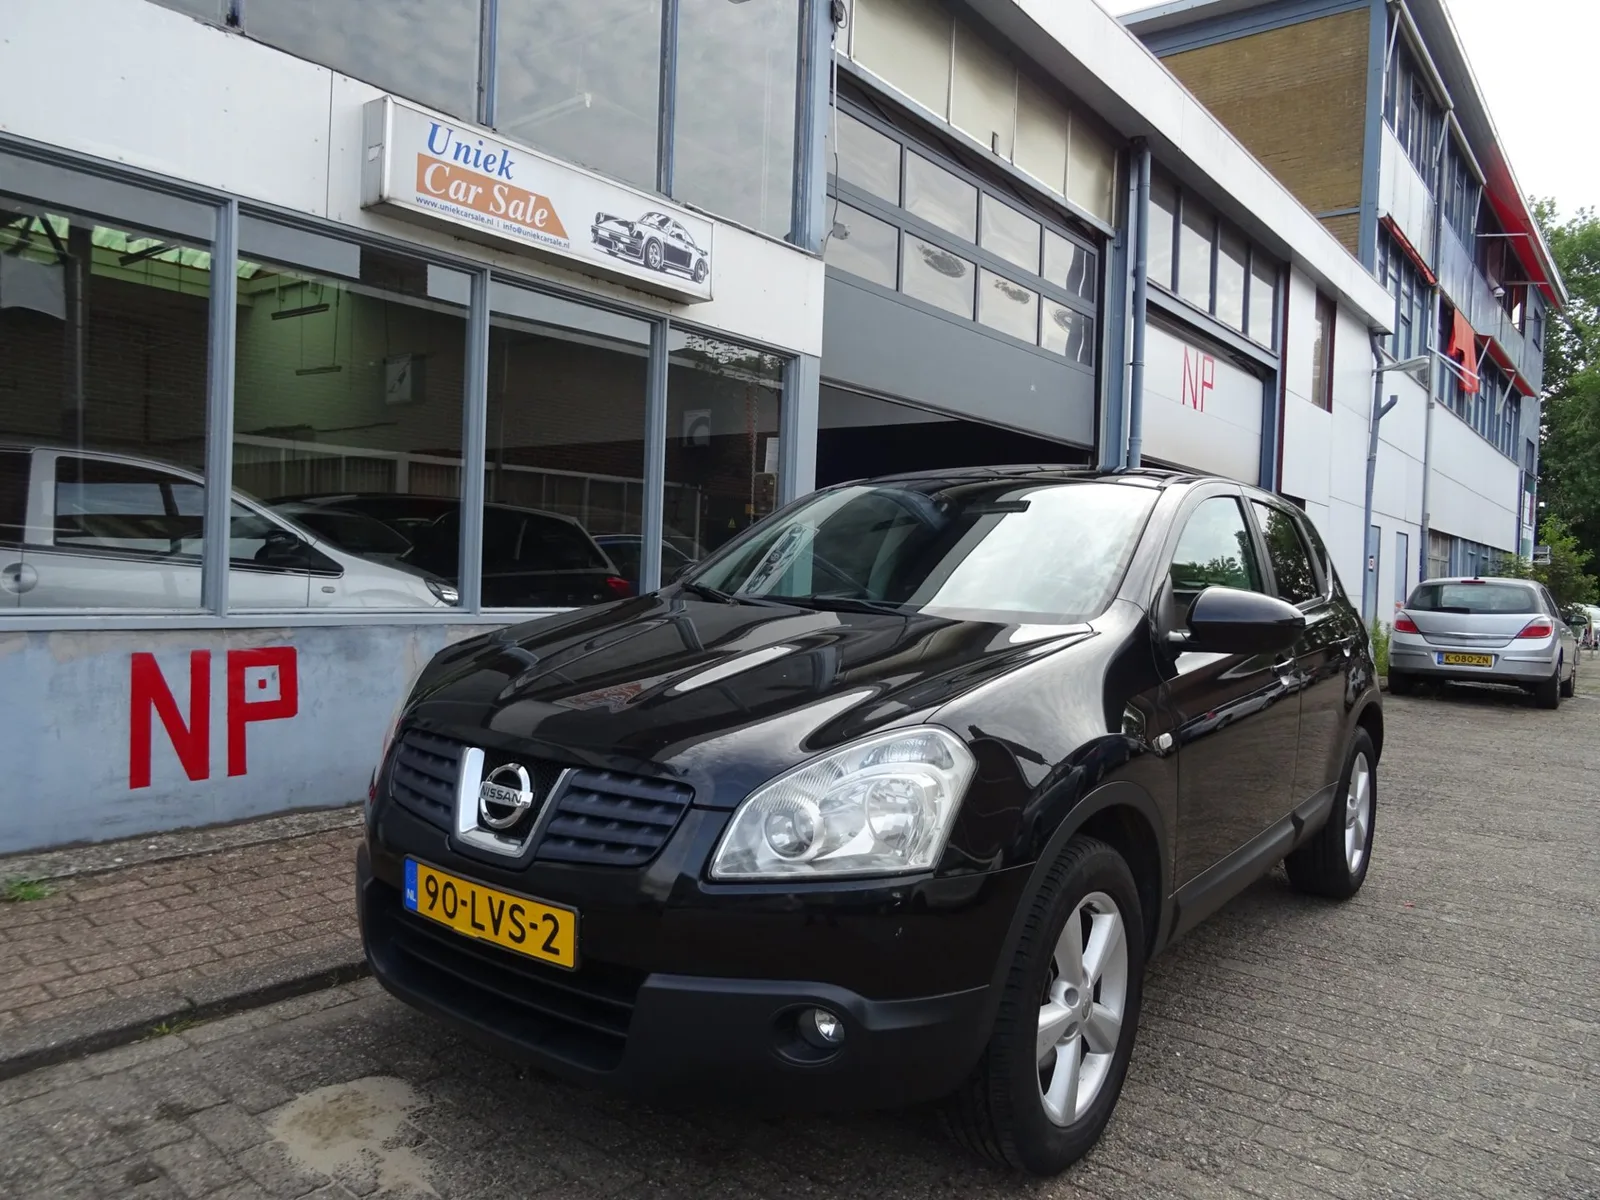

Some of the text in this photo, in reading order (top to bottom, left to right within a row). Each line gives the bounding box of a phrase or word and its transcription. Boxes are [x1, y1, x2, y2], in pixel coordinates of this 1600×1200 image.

[427, 121, 515, 180] Uniek
[415, 196, 494, 225] www.uniekcarsale.nl
[503, 222, 570, 249] info@uniekcarsale.nl
[423, 163, 549, 228] Car Sale
[1182, 344, 1214, 412] NP
[1445, 654, 1489, 664] K-080-ZN
[129, 646, 298, 789] NP
[481, 785, 522, 804] NISSAN
[406, 888, 417, 902] NL
[425, 874, 561, 956] 90-LVS-2
